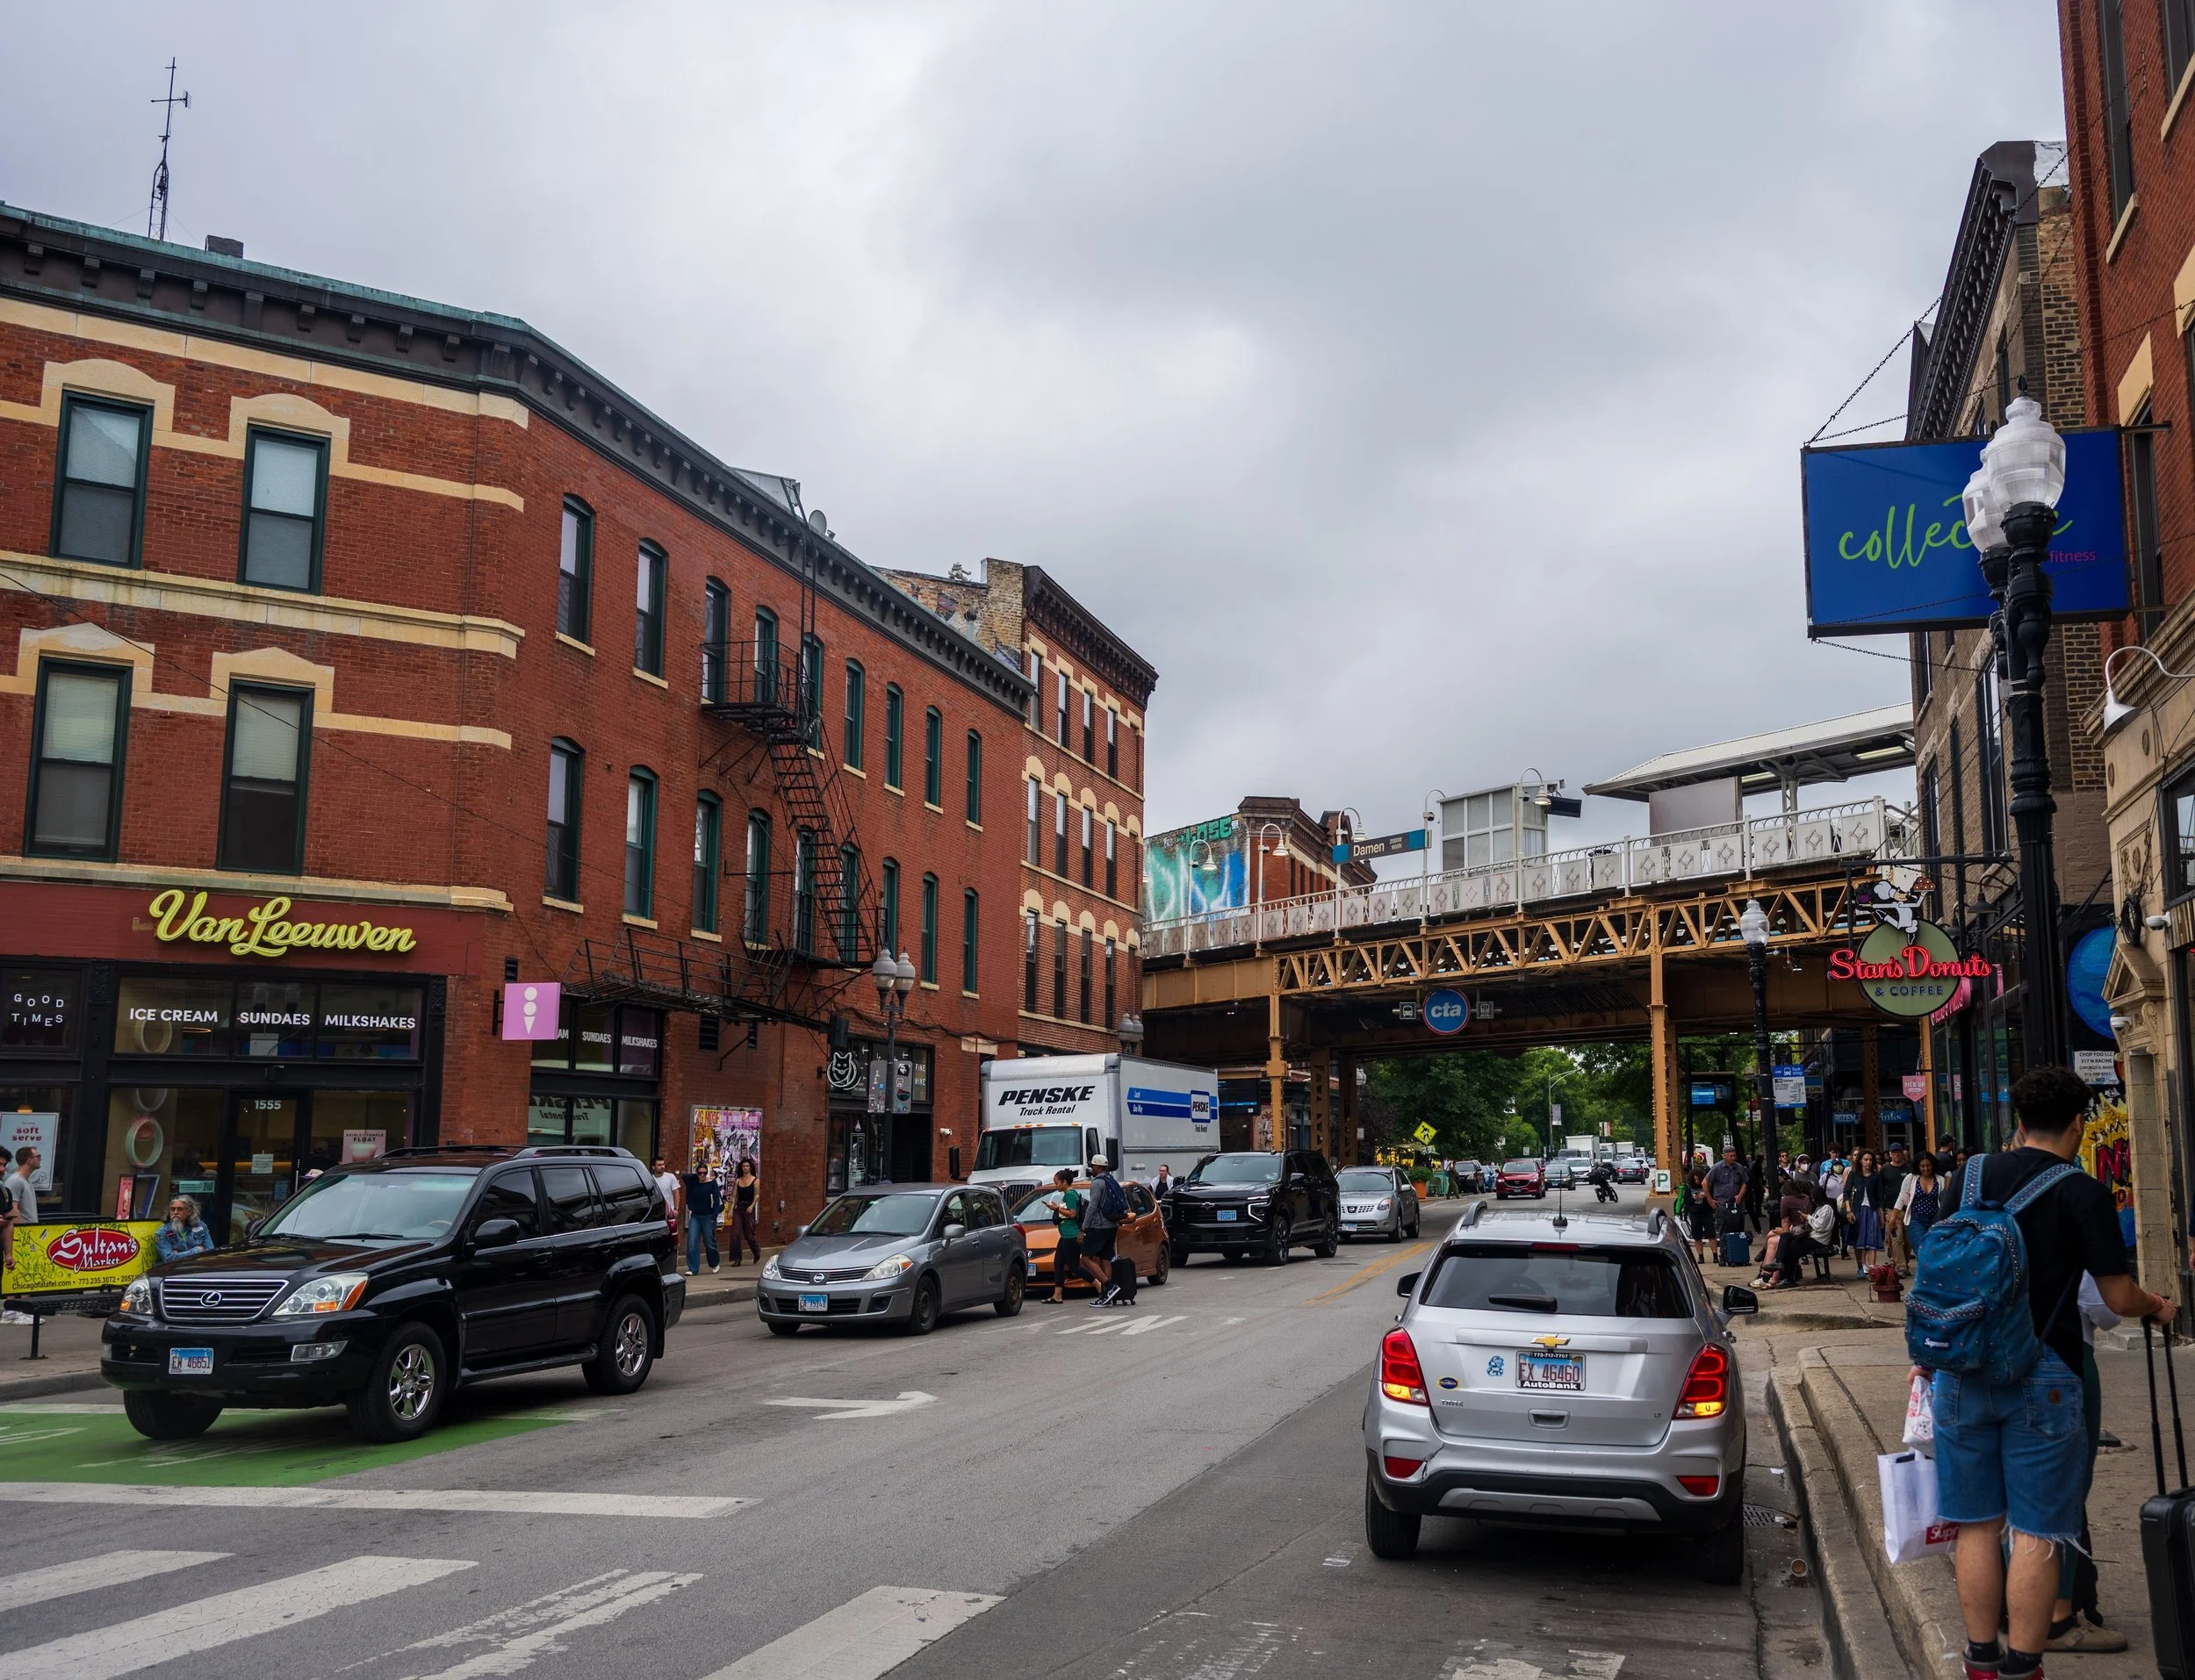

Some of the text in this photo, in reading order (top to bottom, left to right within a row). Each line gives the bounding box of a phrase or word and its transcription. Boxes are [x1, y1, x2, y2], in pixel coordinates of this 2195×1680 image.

[2049, 549, 2097, 563] fitness
[1353, 843, 1385, 857] Damen
[148, 889, 417, 957] Van Leeuwen
[1829, 945, 1992, 980] Stan's Donuts
[1875, 986, 1943, 997] & COFFEE
[14, 994, 64, 1008] GOOD
[1430, 1002, 1462, 1018] cta
[11, 1013, 63, 1026] TIMES
[129, 1008, 416, 1029] ICE CREAM SUNDAES MILKSHAKES
[582, 1031, 612, 1044] SUNDAES
[621, 1036, 658, 1048] MILKSHAKES
[915, 1063, 926, 1072] FINE
[998, 1086, 1096, 1106] PENSKE
[254, 1100, 282, 1109] 1555
[1019, 1104, 1076, 1116] Truck Rental
[1191, 1101, 1209, 1113] PENSKE
[1657, 1173, 1668, 1187] P
[49, 1227, 137, 1262] Sultan's
[74, 1253, 120, 1273] Market
[12, 1280, 72, 1290] Chicagofalafel.com
[78, 1276, 116, 1285] 773.235.3072
[1542, 1364, 1580, 1382] 46460
[1522, 1381, 1578, 1389] AutoBank
